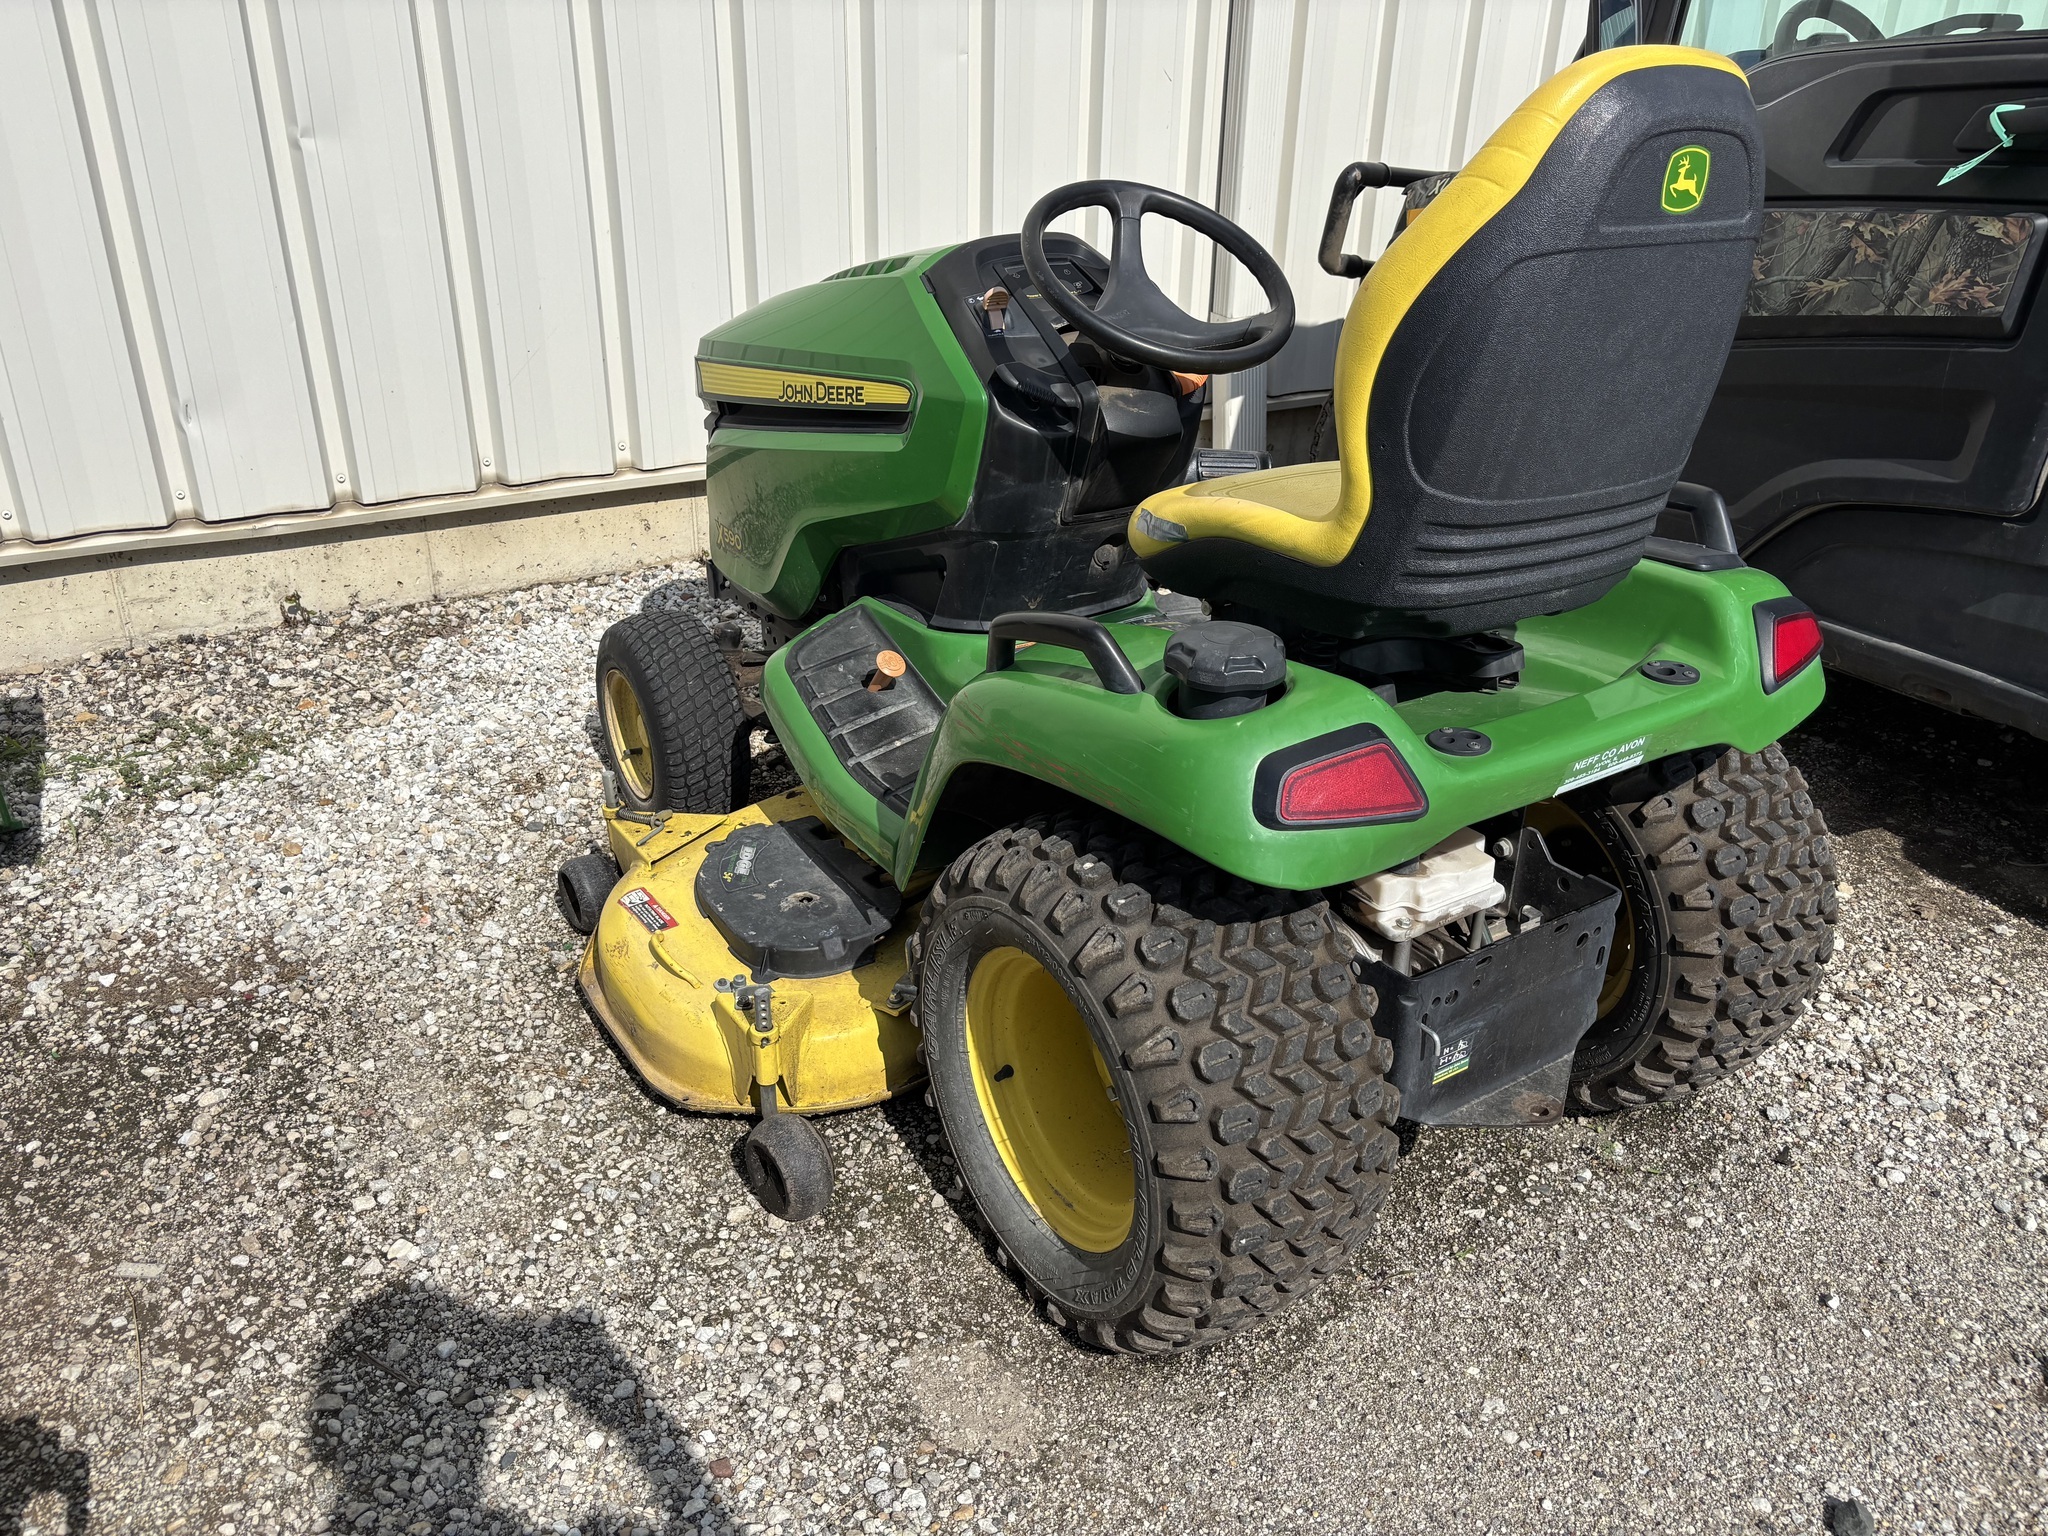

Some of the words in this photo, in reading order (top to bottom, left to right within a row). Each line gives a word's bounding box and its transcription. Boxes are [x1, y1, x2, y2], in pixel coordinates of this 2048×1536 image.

[778, 380, 814, 402] JOHN
[815, 381, 865, 404] DEERE
[716, 520, 743, 552] X590
[1572, 754, 1600, 771] NEFF
[1601, 748, 1617, 760] CO
[1617, 737, 1646, 755] AVON
[734, 844, 757, 876] EDGE
[656, 906, 671, 921] DANGER
[923, 917, 964, 1061] CARLISLE
[1125, 1188, 1150, 1282] FIELD
[1073, 1279, 1128, 1305] TRAX
